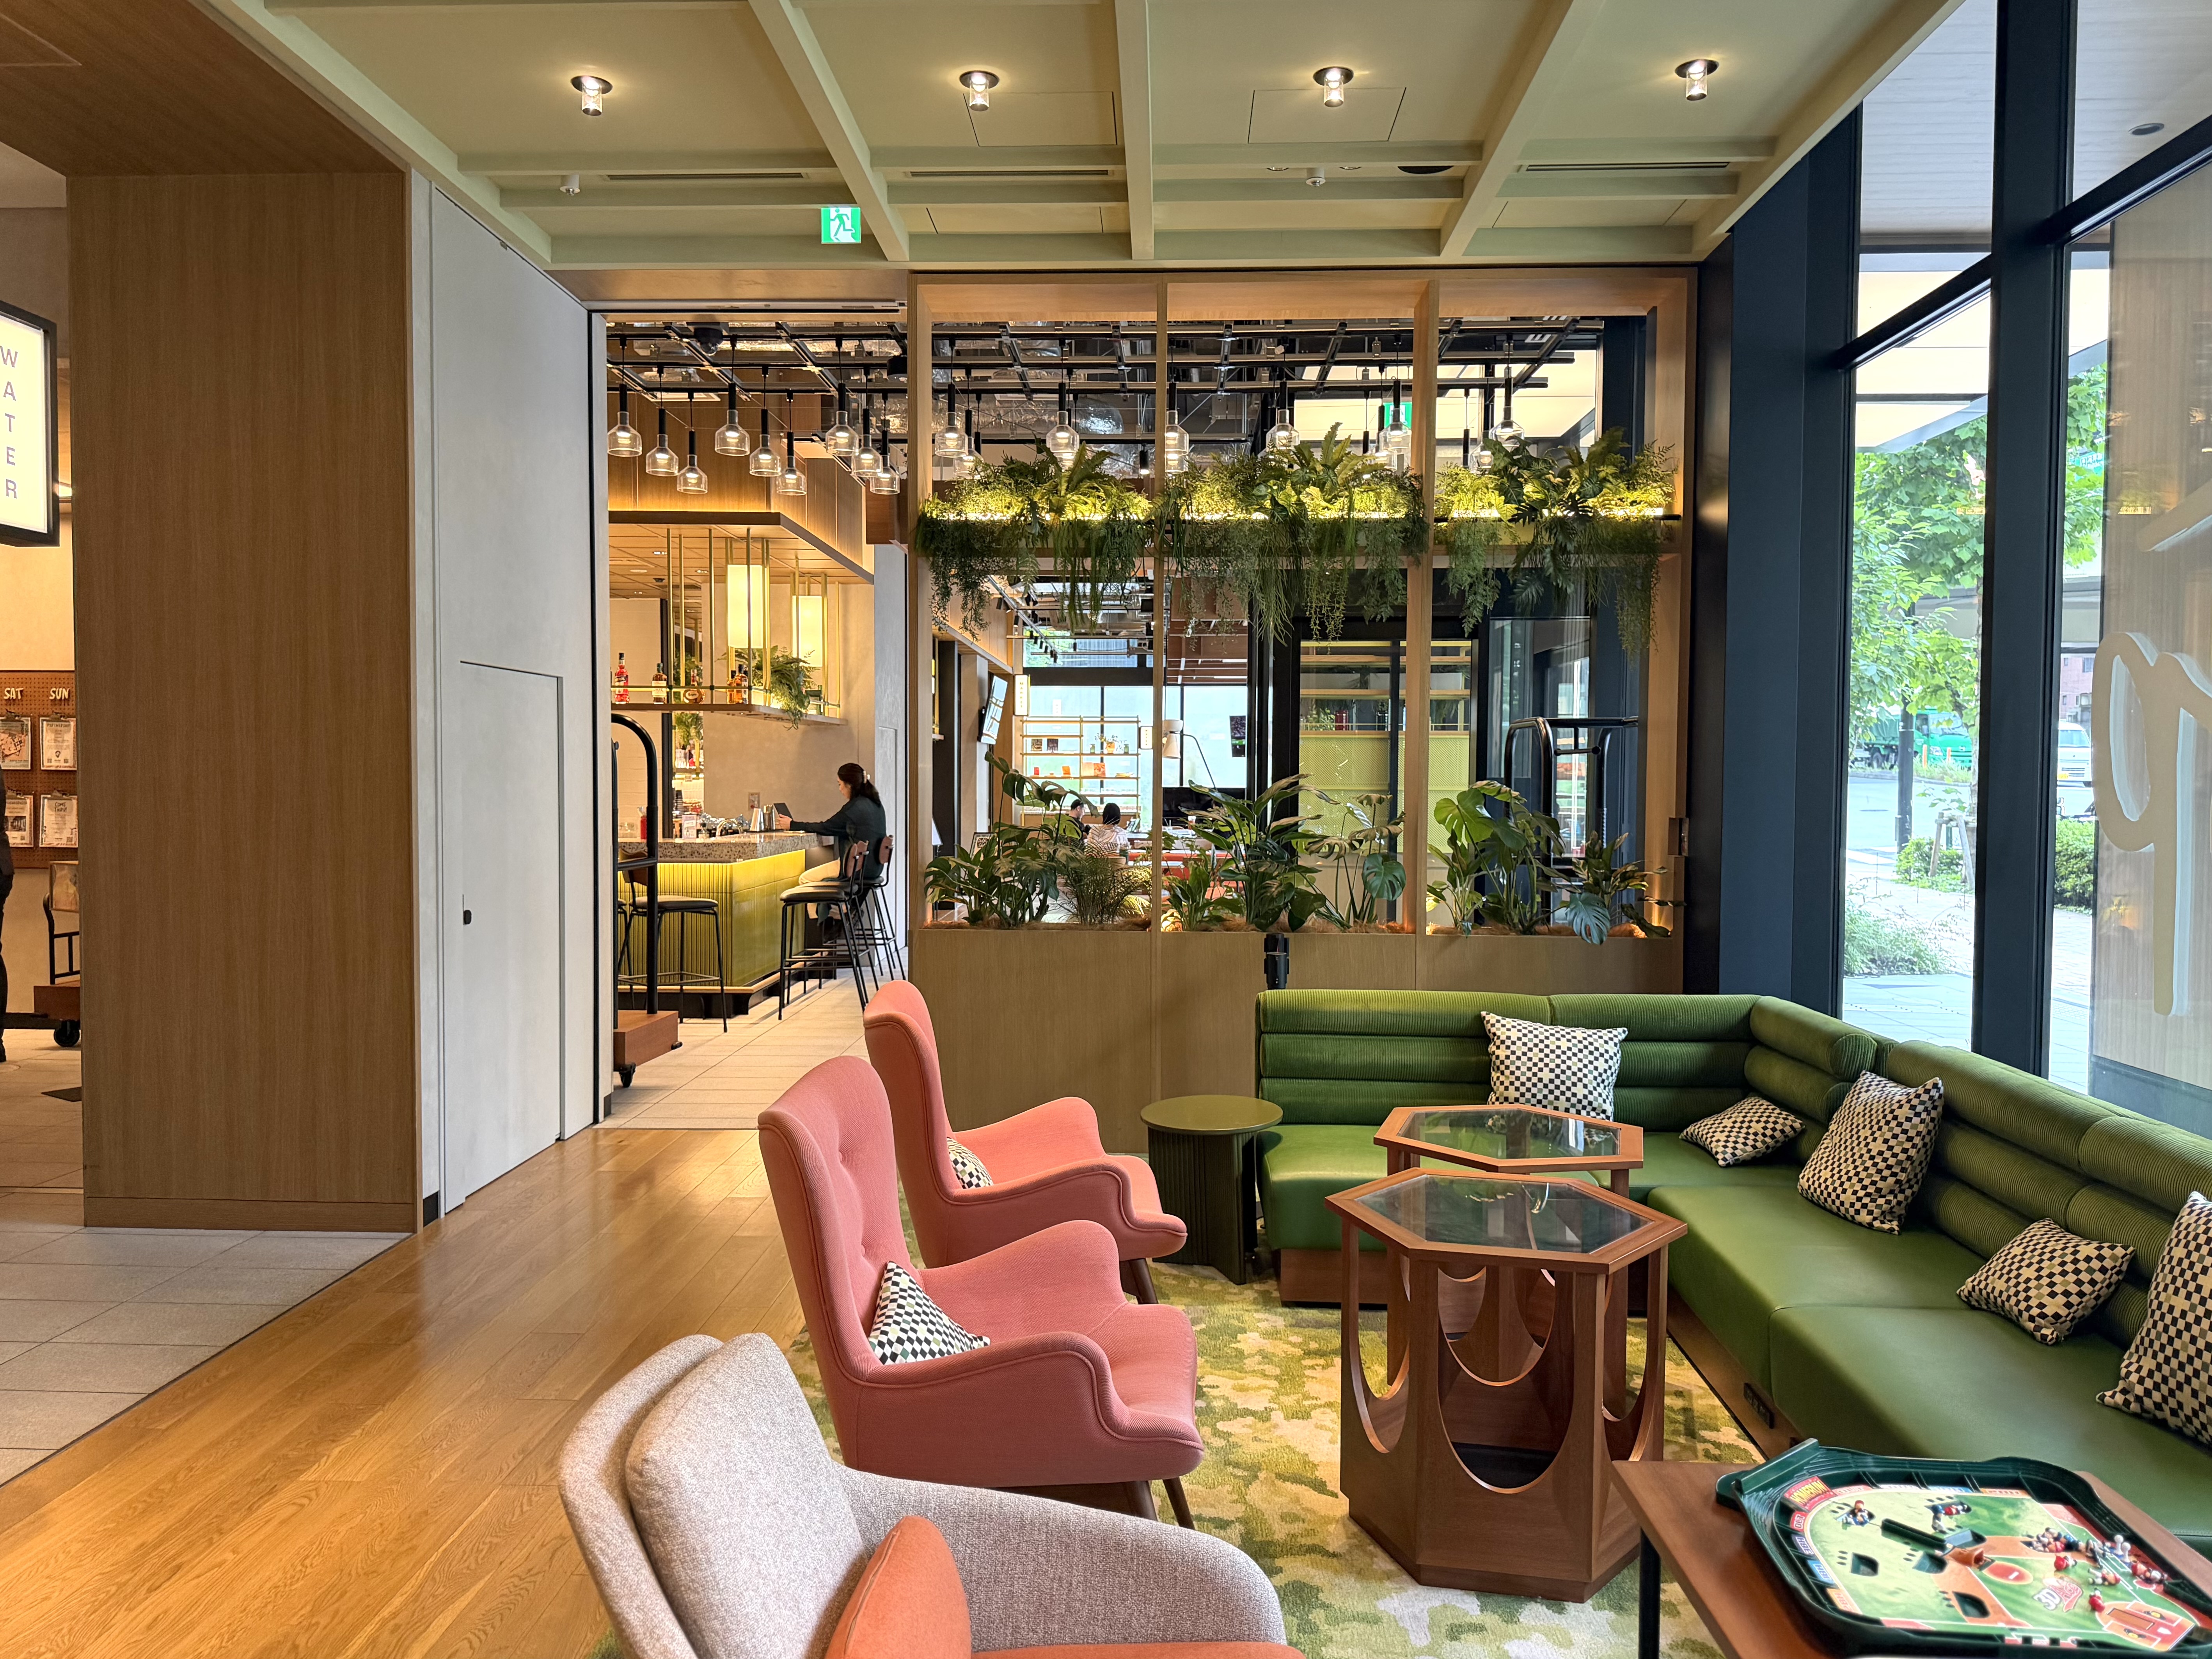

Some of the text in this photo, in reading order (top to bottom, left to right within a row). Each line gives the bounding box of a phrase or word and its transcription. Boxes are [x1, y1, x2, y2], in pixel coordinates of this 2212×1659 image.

[0, 346, 18, 498] WATER
[4, 688, 24, 699] SAT
[49, 688, 70, 700] SUN
[1789, 1480, 1828, 1505] HOMERUN
[1794, 1514, 1805, 1529] OUT
[2032, 1588, 2061, 1610] 3D
